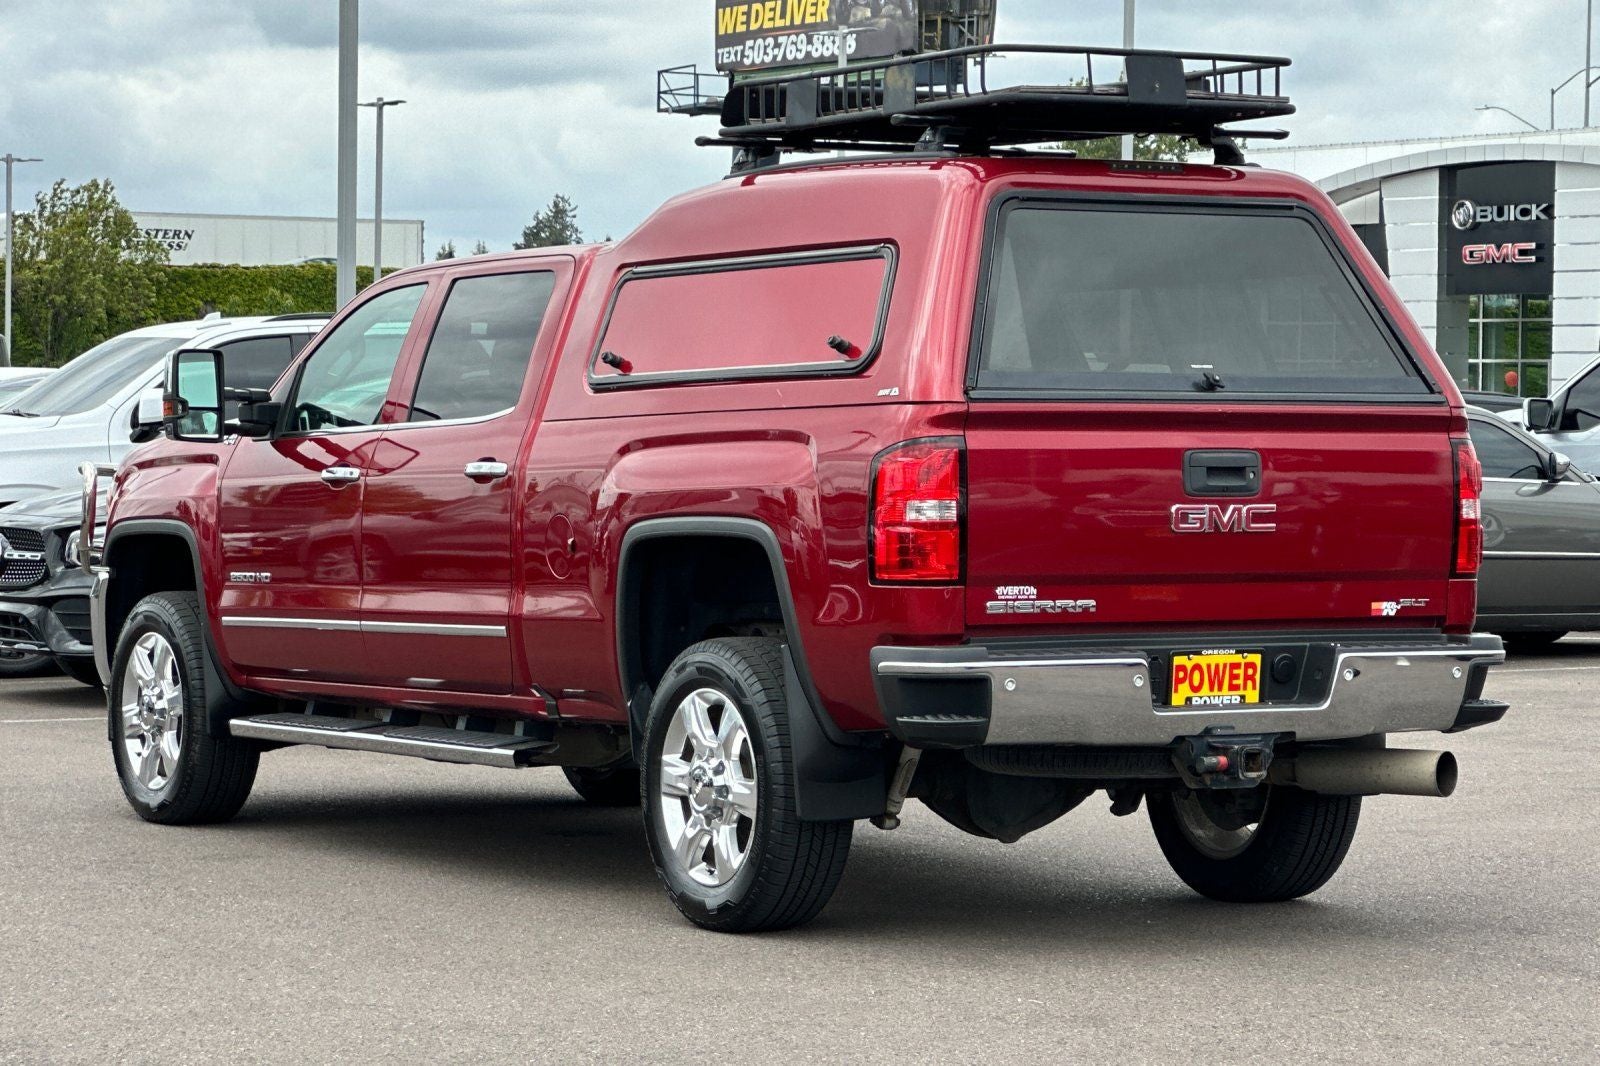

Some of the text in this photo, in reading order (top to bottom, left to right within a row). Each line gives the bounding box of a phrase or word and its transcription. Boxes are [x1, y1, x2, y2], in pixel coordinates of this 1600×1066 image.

[718, 0, 829, 35] WE DELIVER
[718, 45, 743, 64] TEXT
[1475, 203, 1549, 222] BUICK
[1462, 242, 1536, 265] GMC
[1171, 504, 1277, 532] GMC
[986, 599, 1097, 614] SIERRA
[1173, 661, 1258, 694] POWER
[1191, 695, 1241, 705] POWER
